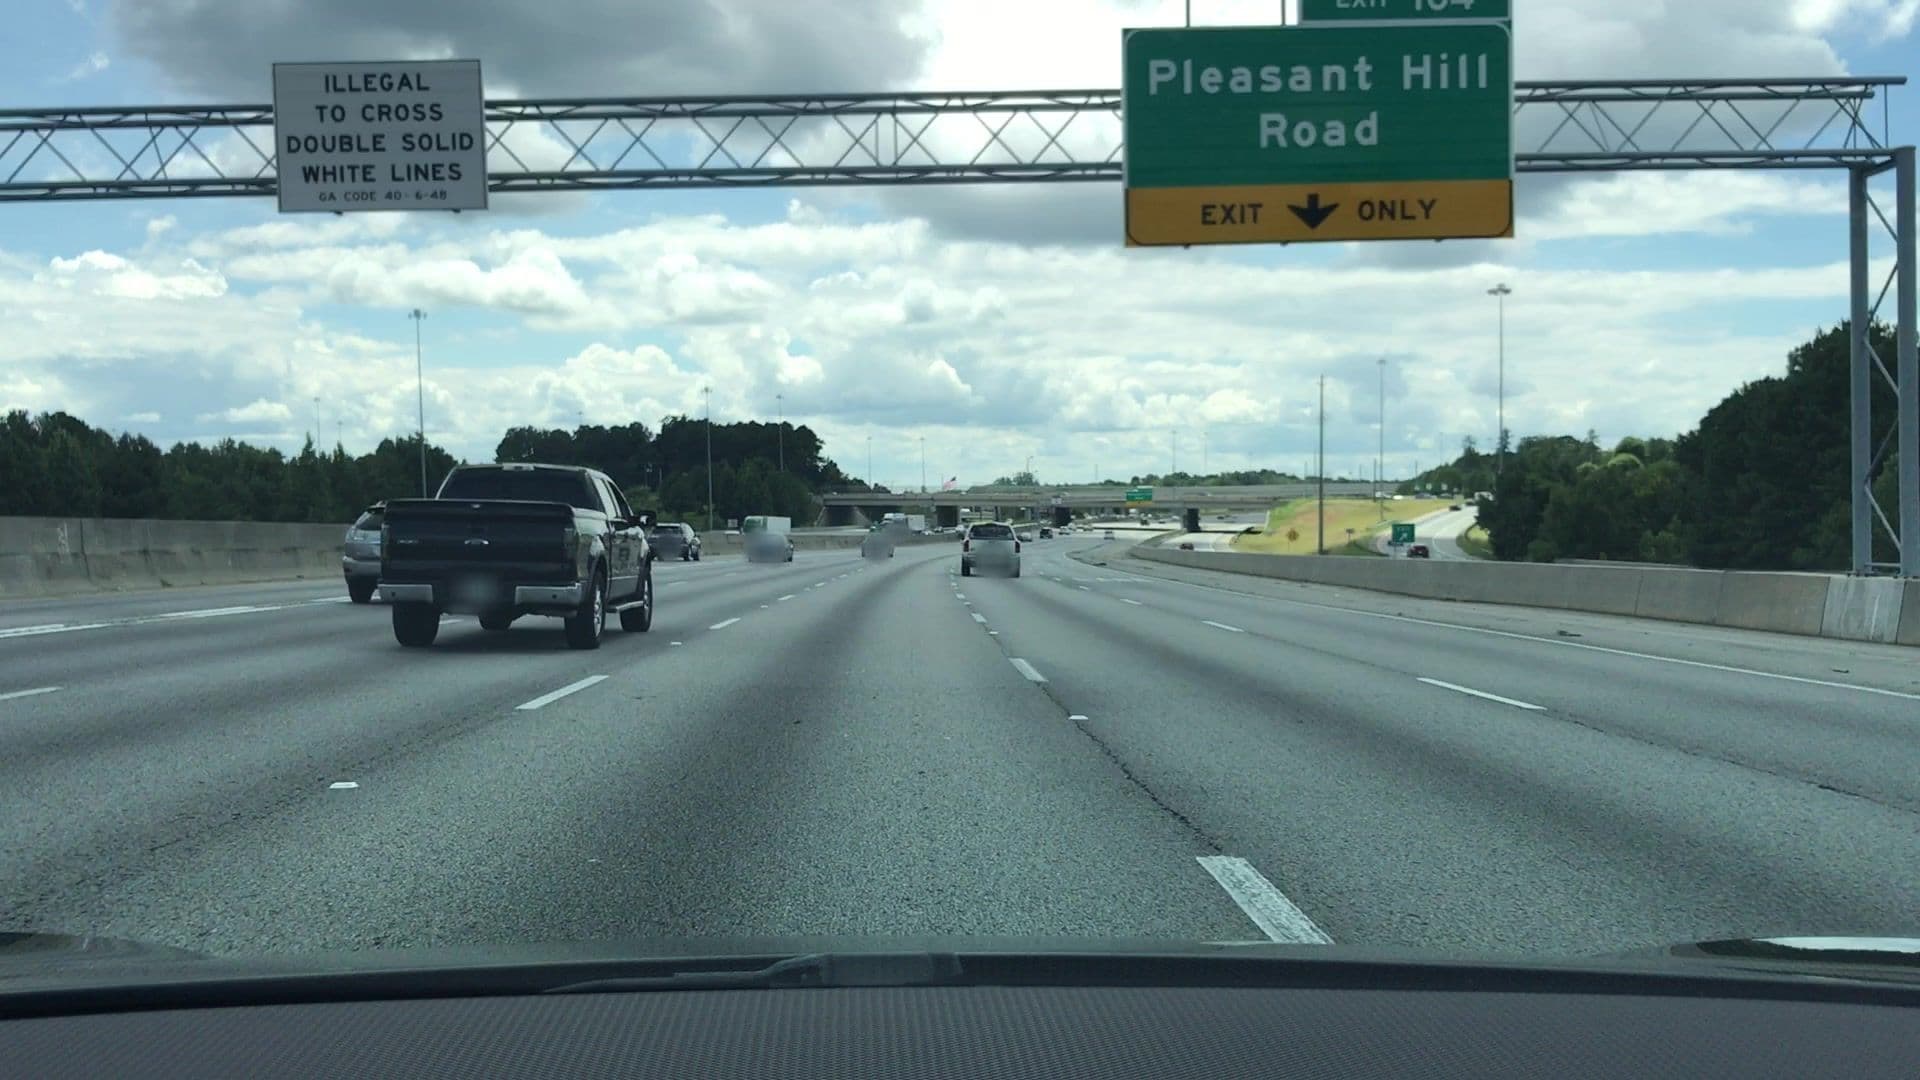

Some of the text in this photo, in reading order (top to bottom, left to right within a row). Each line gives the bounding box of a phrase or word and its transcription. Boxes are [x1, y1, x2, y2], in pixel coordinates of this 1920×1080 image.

[325, 73, 430, 93] ILLEGAL
[1149, 53, 1487, 95] Pleasant Hill
[315, 103, 444, 123] TO CROSS
[1259, 111, 1378, 148] Road
[287, 132, 474, 154] DOUBLE SOLID
[302, 163, 462, 184] WHITE LINES
[319, 191, 337, 202] GA
[343, 191, 377, 202] CODE
[1201, 199, 1437, 225] EXIT ONLY
